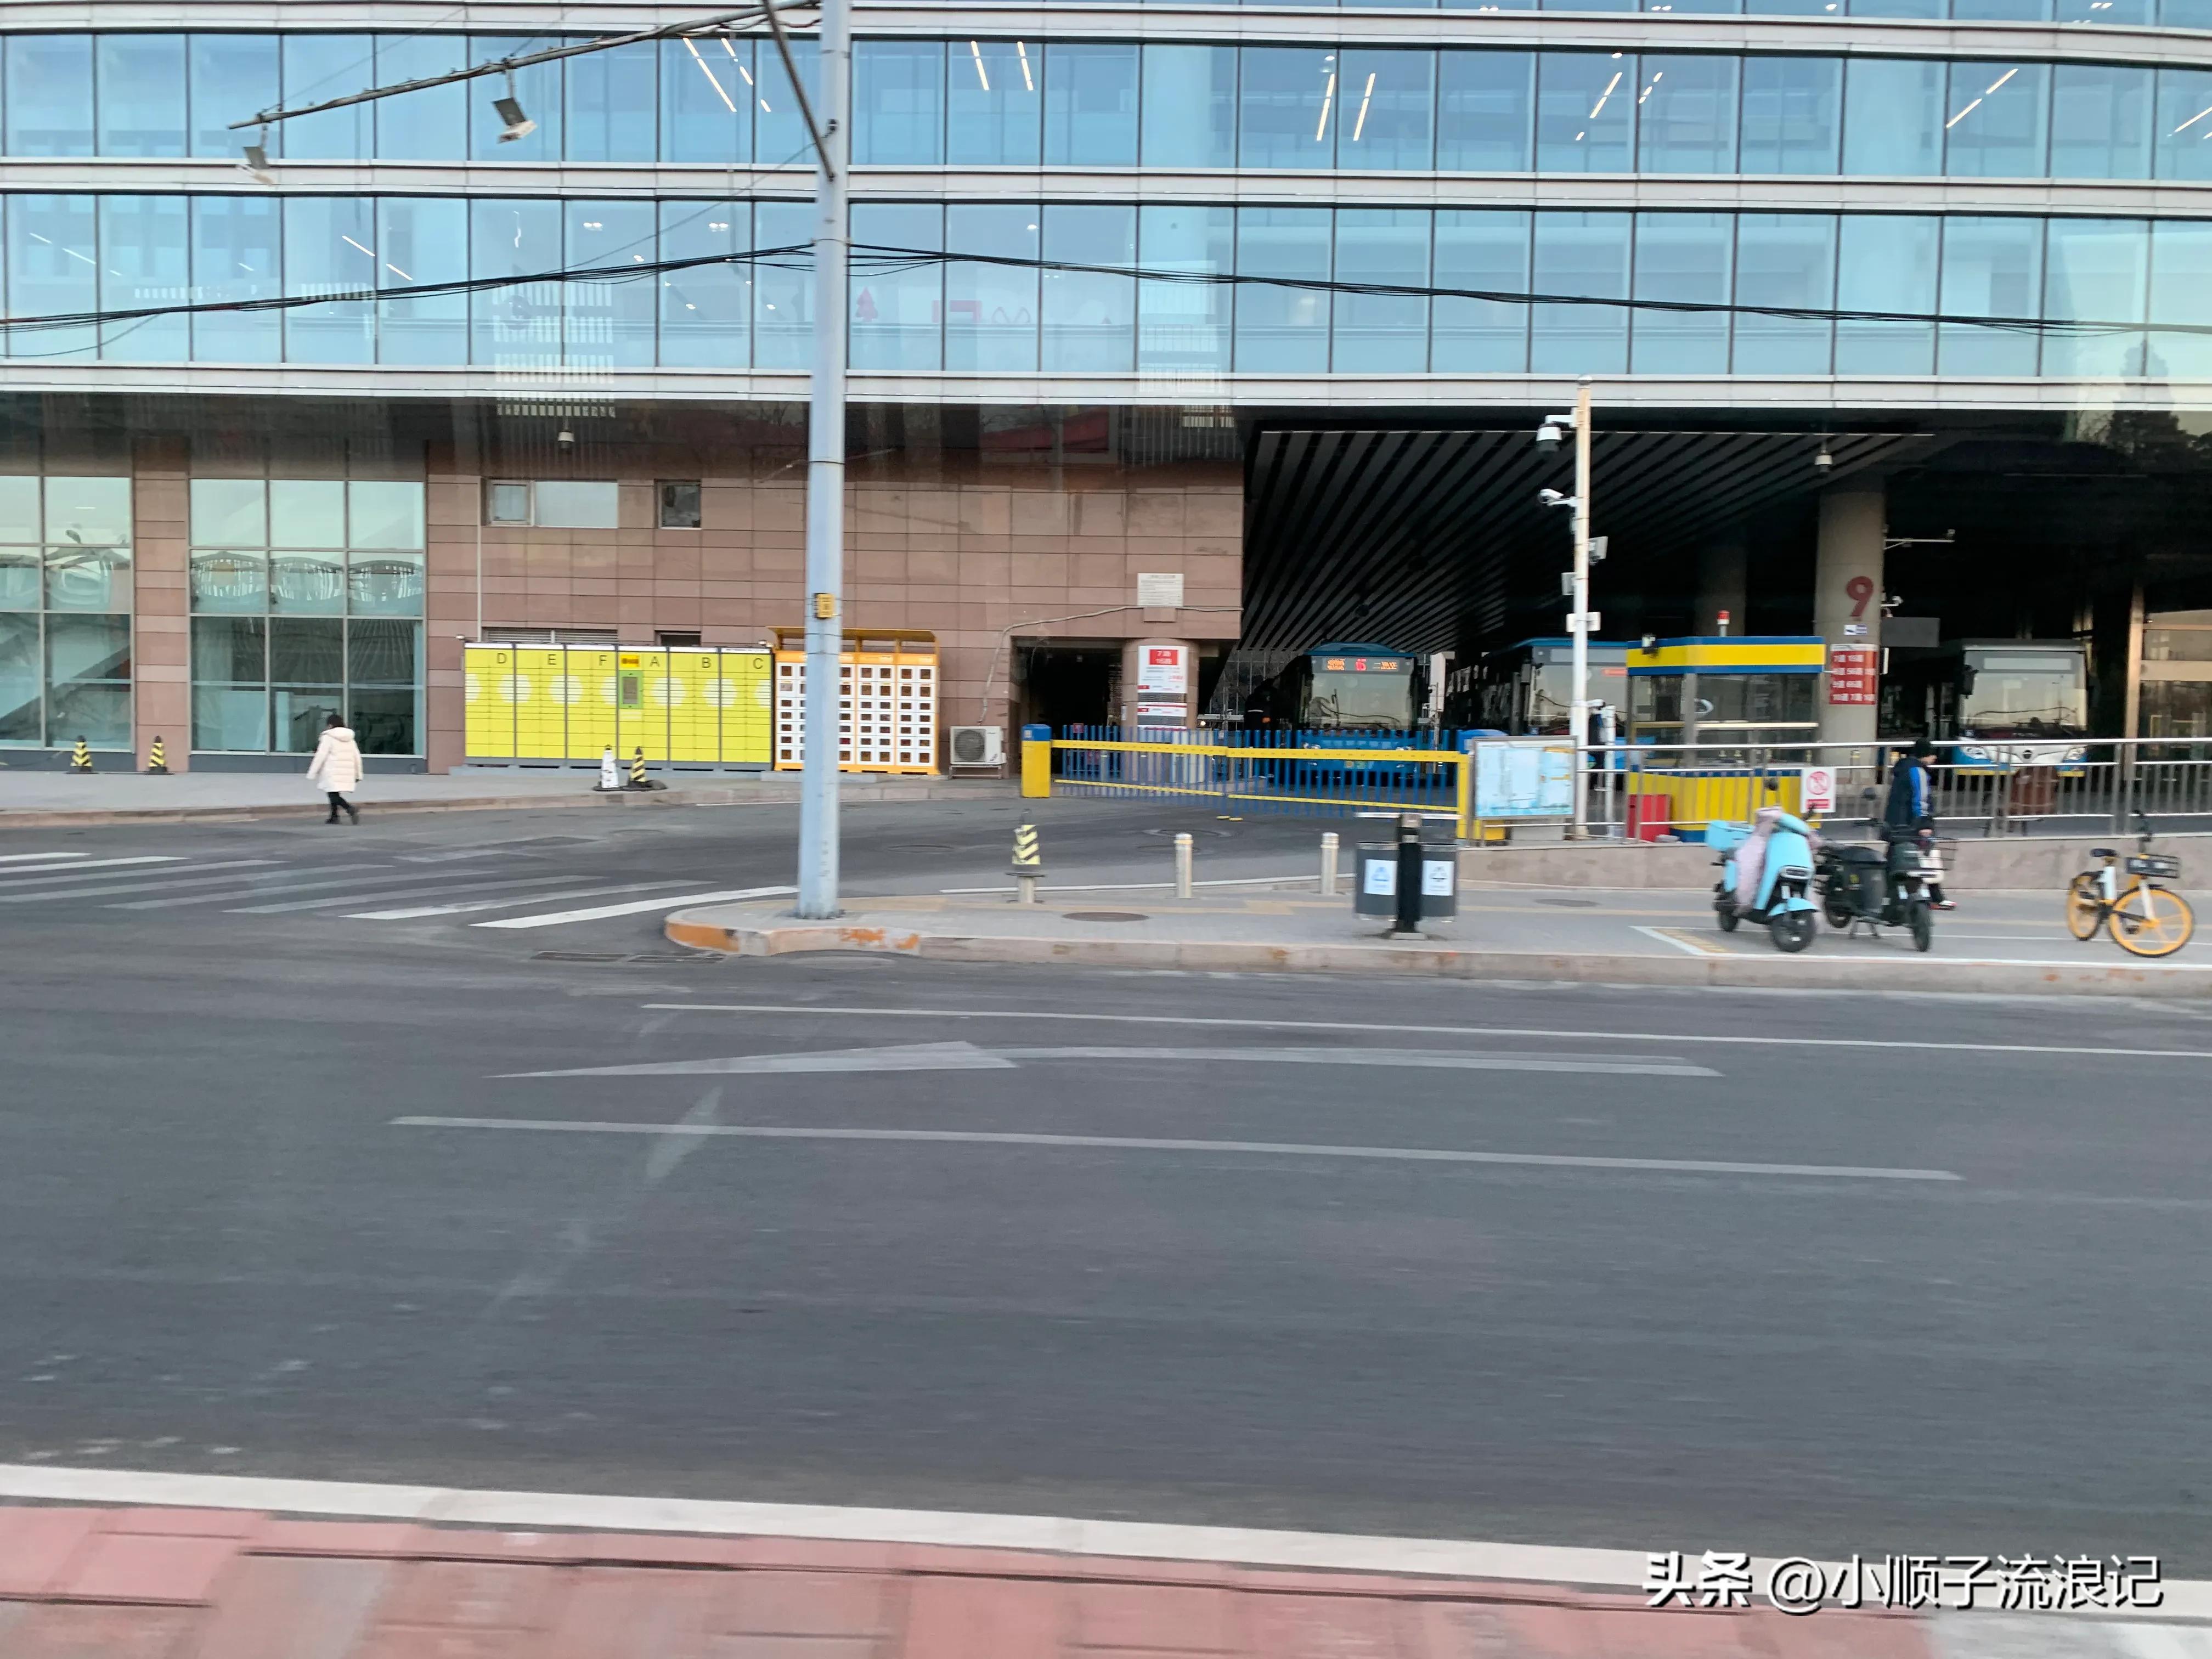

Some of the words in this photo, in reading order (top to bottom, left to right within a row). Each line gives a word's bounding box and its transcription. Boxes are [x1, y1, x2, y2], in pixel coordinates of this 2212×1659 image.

[1846, 576, 1874, 617] 9
[496, 653, 507, 664] D
[548, 654, 557, 665] E
[599, 655, 607, 666] F
[650, 656, 660, 667] A
[702, 657, 712, 668] B
[753, 658, 764, 669] C
